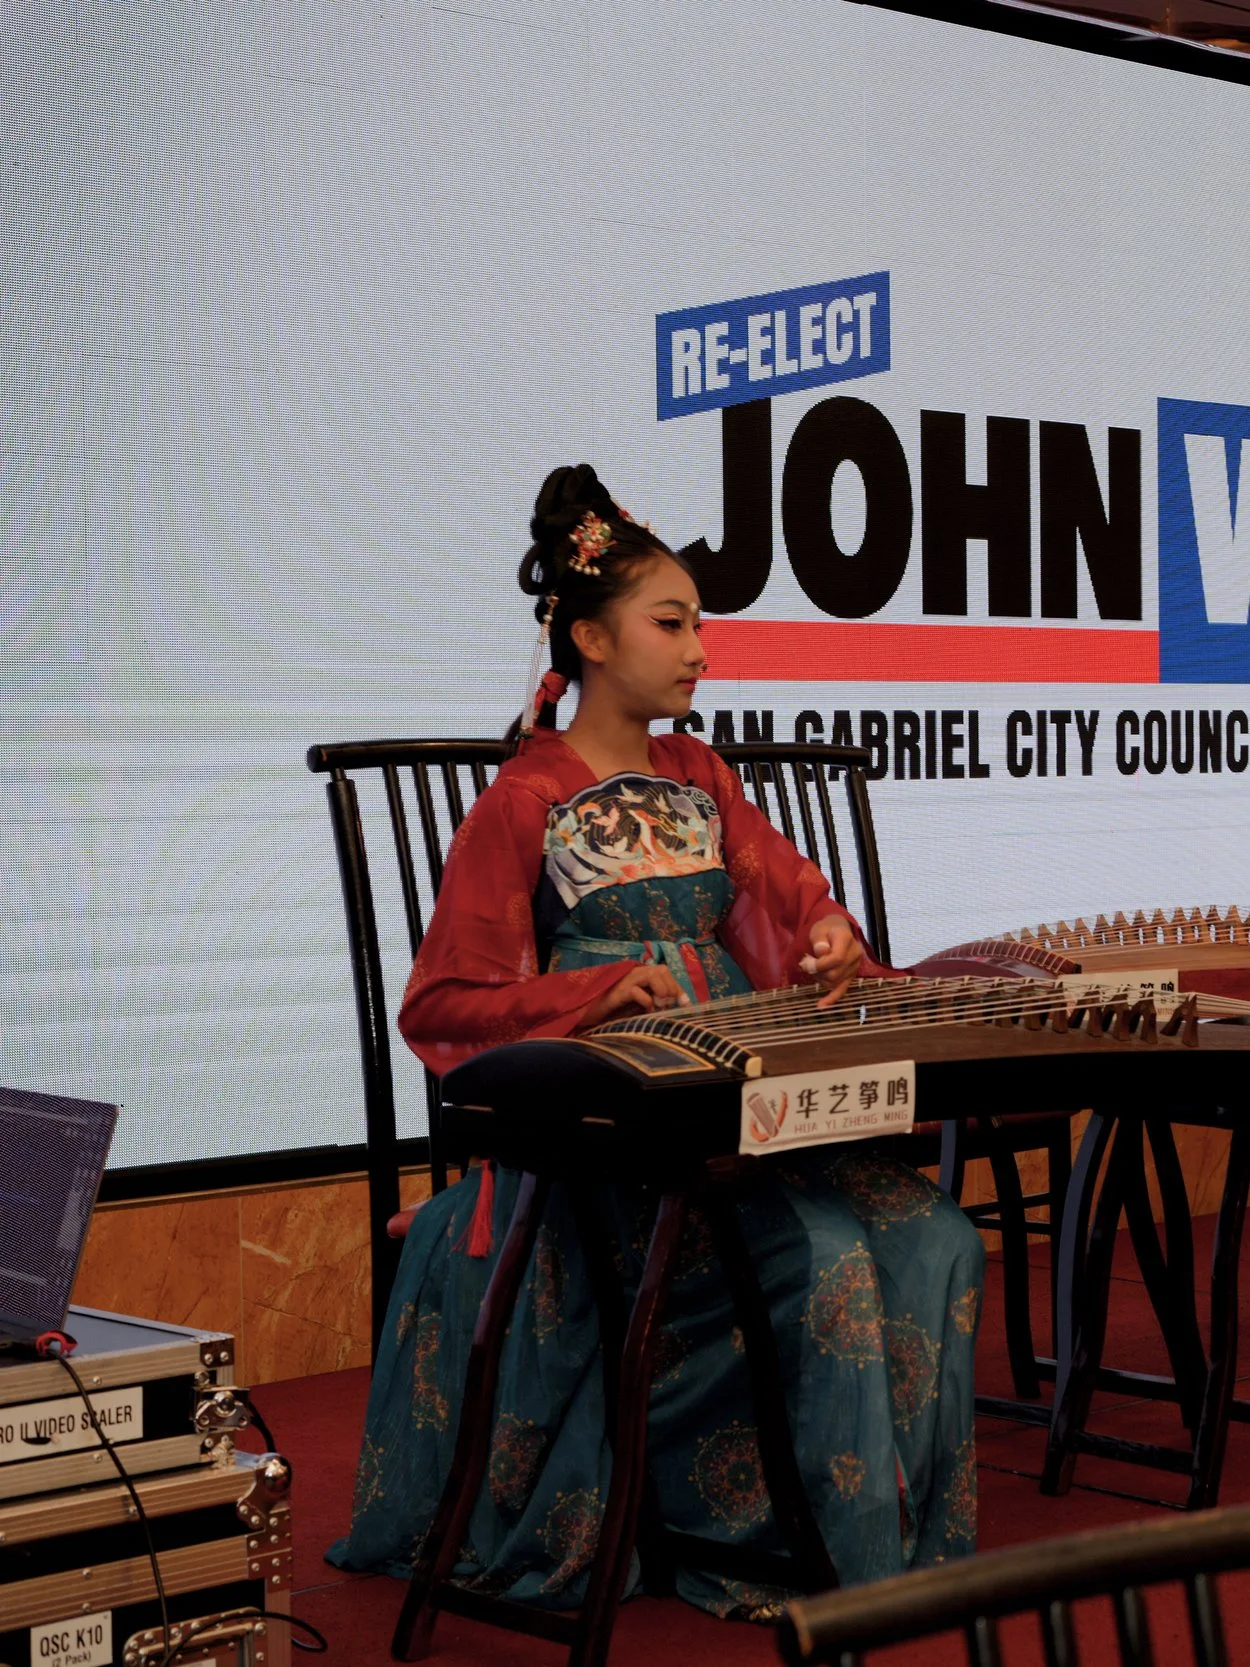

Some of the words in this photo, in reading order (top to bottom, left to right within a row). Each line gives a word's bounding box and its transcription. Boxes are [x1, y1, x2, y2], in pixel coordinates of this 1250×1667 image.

[671, 291, 877, 399] RE-ELECT
[680, 396, 1142, 621] JOHN
[794, 709, 990, 782] GABRIEL
[1006, 708, 1098, 780] CITY
[796, 1076, 909, 1119] 华艺筝鸣
[794, 1121, 818, 1134] HUA
[825, 1119, 836, 1131] YI
[842, 1112, 878, 1128] ZHENG
[883, 1108, 909, 1123] MING
[34, 1414, 75, 1439] VIDEO
[40, 1631, 70, 1657] QSC
[76, 1624, 103, 1649] K10
[65, 1650, 91, 1665] Pack)
